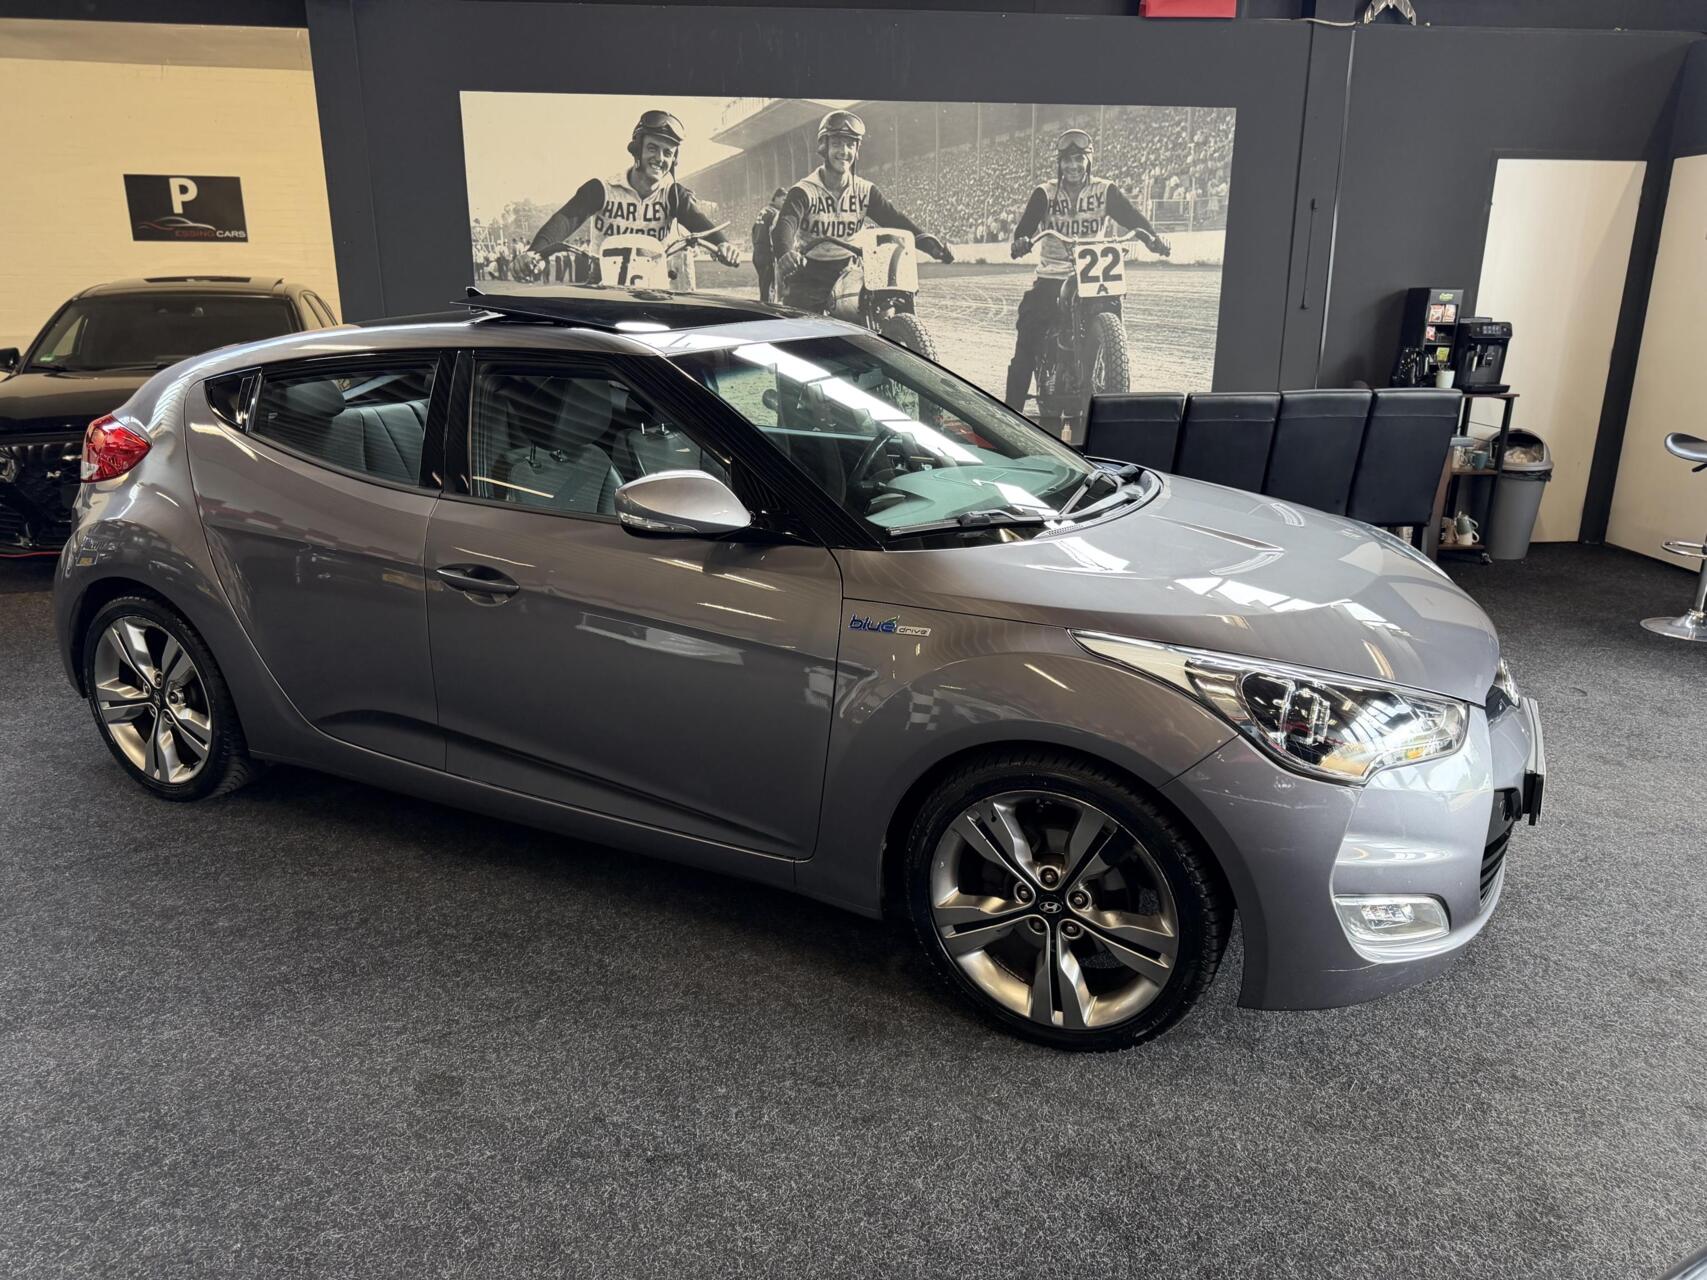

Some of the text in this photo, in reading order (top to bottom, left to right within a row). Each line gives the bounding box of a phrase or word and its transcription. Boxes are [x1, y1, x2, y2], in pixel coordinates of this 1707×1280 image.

[169, 177, 198, 214] P
[215, 230, 246, 238] CARS
[1078, 246, 1123, 284] 22
[1097, 283, 1109, 295] A
[898, 626, 928, 635] drive
